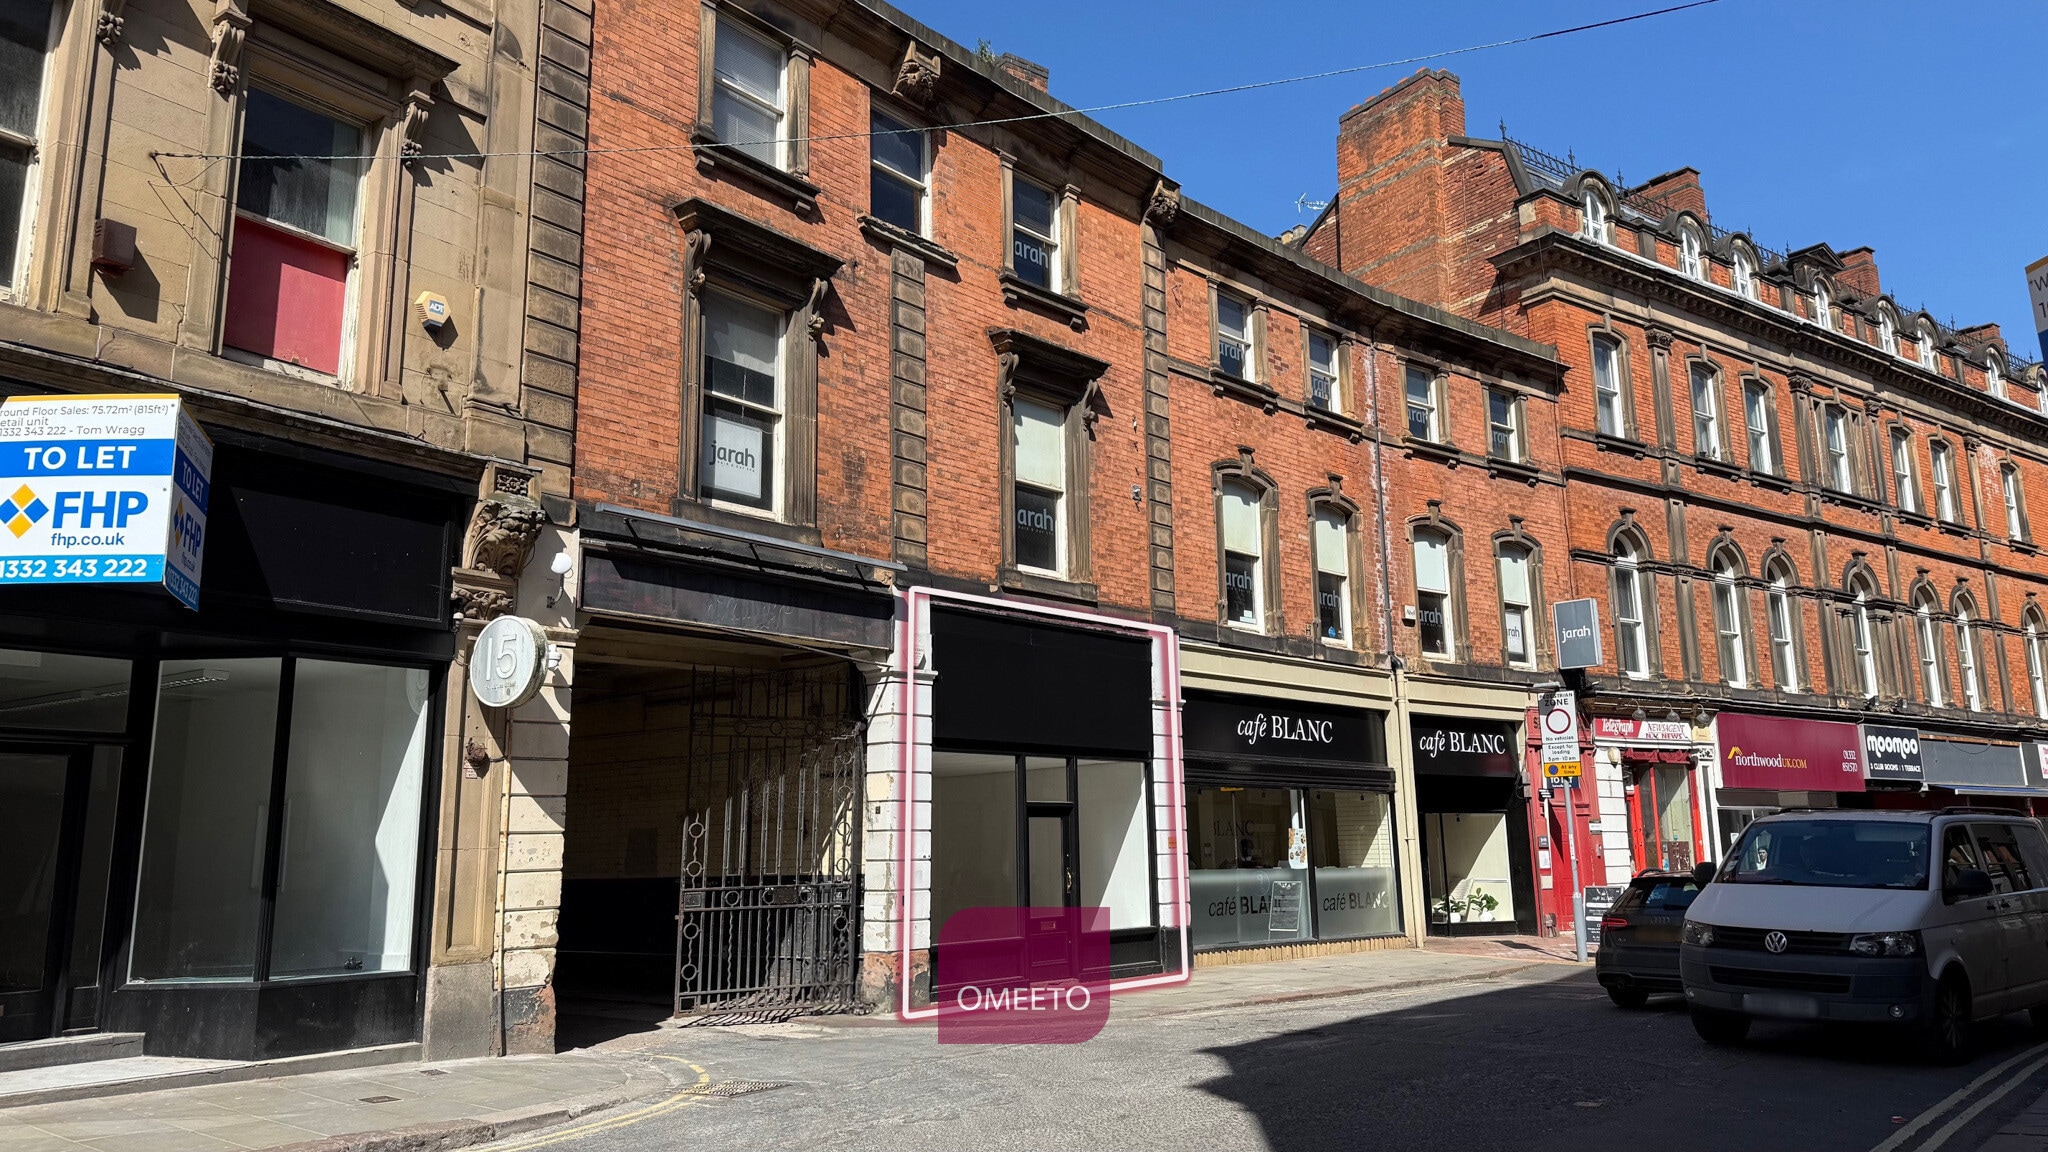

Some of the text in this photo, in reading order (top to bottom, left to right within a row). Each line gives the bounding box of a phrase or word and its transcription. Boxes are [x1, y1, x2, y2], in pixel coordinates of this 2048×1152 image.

[1014, 240, 1048, 269] arah
[430, 302, 444, 313] ADT
[0, 407, 29, 417] round
[32, 407, 58, 416] Floor
[61, 406, 90, 415] Sales:
[0, 417, 48, 427] etail unit
[0, 427, 21, 437] 1332
[23, 427, 44, 436] 343
[47, 426, 66, 436] 222
[77, 425, 101, 435] Tom
[105, 425, 145, 437] Wragg
[24, 445, 137, 471] TO LET
[709, 440, 755, 469] jarah
[183, 460, 204, 503] TO LET
[52, 491, 149, 528] FHP
[1017, 508, 1054, 532] arah
[51, 532, 125, 549] fhp.co.uk
[183, 511, 202, 558] FHP
[0, 559, 147, 578] 1332 343 222
[1226, 571, 1251, 590] arah
[1419, 607, 1442, 625] arah
[1508, 626, 1520, 637] rah
[1561, 625, 1591, 643] jarah
[486, 634, 518, 681] 15
[1237, 713, 1333, 745] café BLANC
[1602, 718, 1634, 735] Telegraph
[1648, 723, 1685, 732] NEWSAGENT
[1420, 730, 1506, 758] café BLANC
[1867, 735, 1918, 759] moomoo
[1208, 896, 1236, 917] café
[1323, 892, 1346, 911] café
